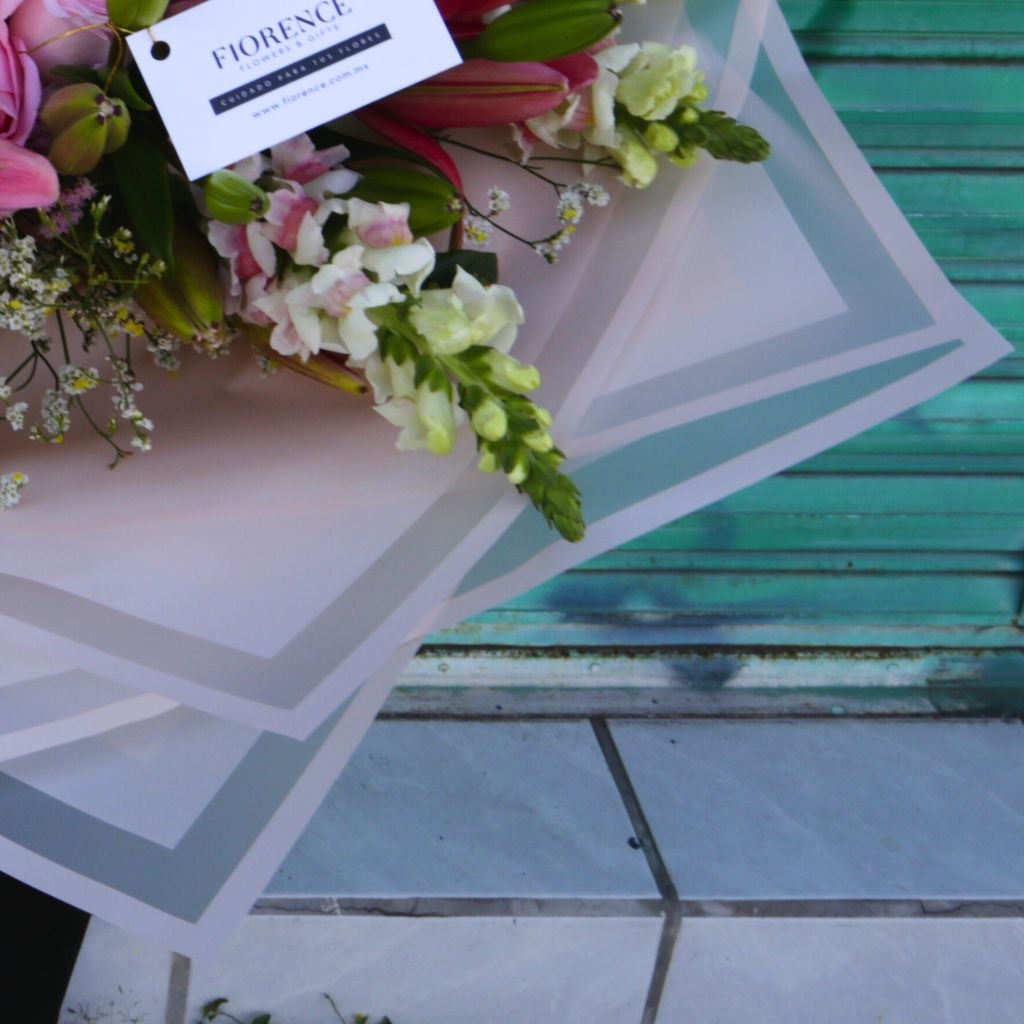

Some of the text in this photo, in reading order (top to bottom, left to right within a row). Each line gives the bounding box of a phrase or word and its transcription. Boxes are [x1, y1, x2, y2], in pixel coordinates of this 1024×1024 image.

[220, 31, 382, 107] CUIDADO PARA TUS FLORES
[239, 24, 340, 72] FLOWERS & GIFTS
[252, 63, 370, 119] www.fiorence.com.mx
